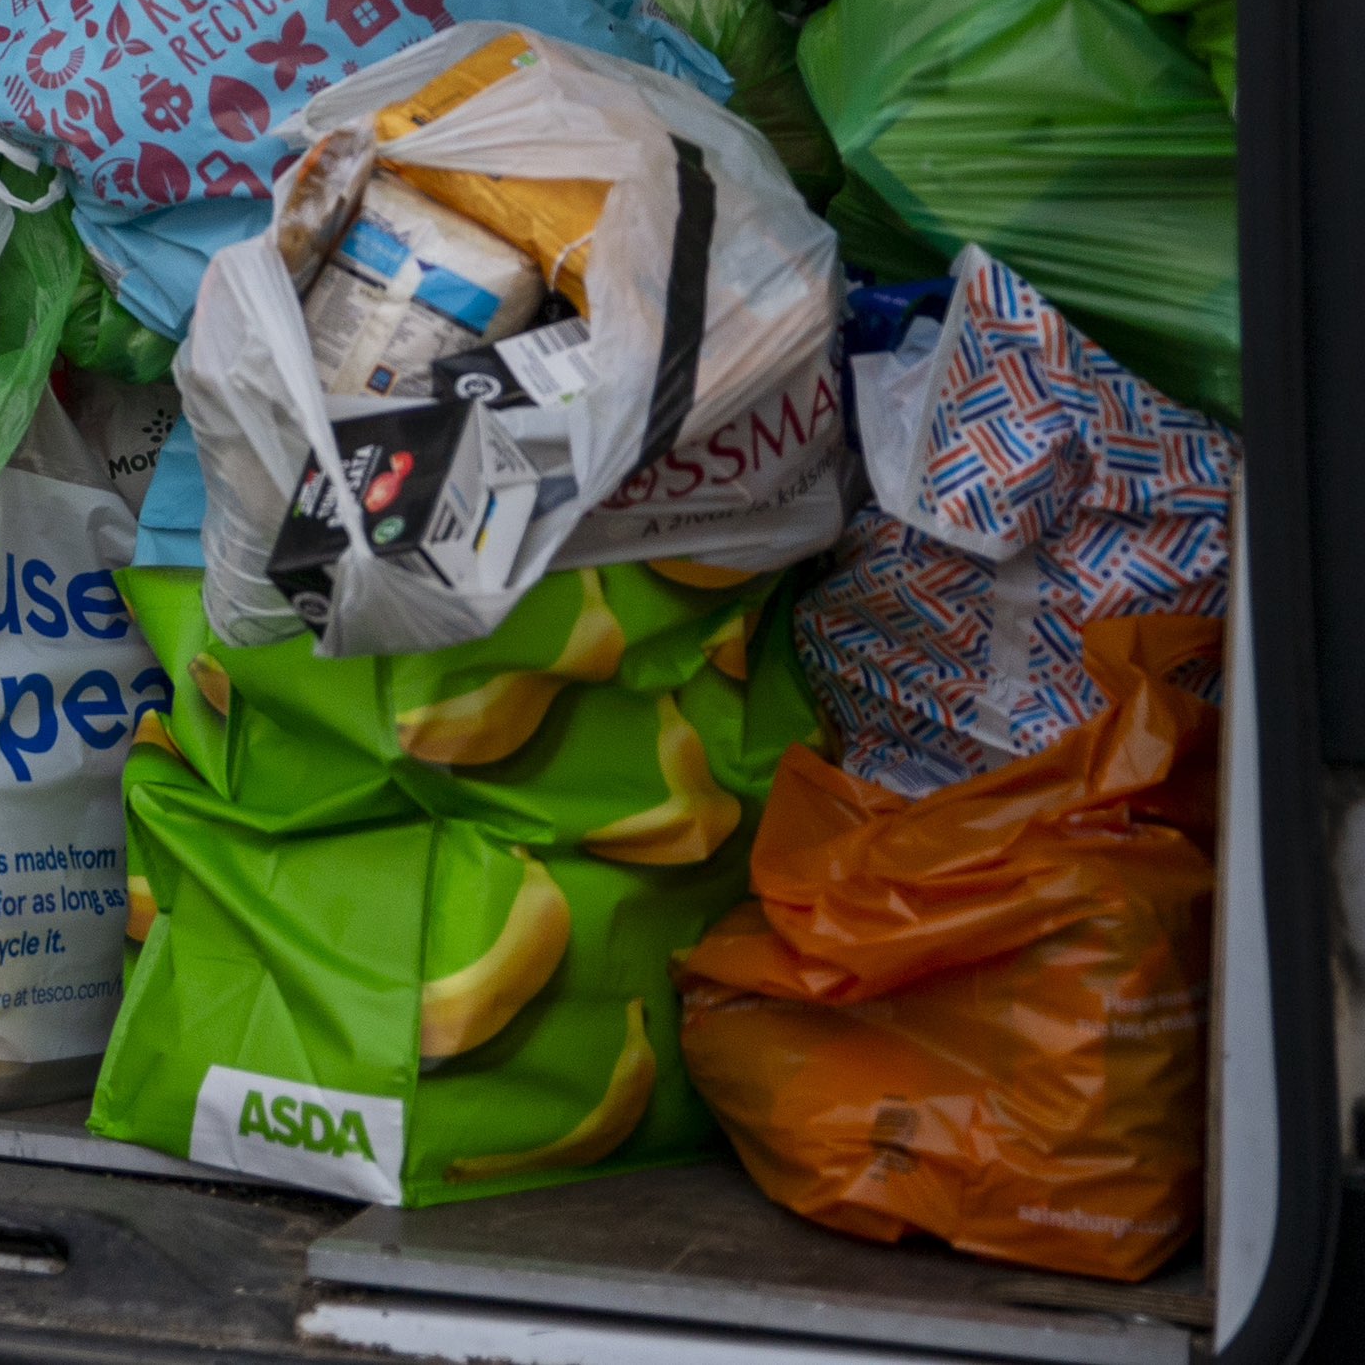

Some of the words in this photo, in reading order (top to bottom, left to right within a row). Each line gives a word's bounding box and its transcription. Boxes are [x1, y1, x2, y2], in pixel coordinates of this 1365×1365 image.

[15, 843, 67, 873] made
[68, 842, 117, 871] from
[32, 891, 57, 915] as
[61, 884, 106, 917] long
[103, 887, 126, 908] as
[45, 928, 67, 954] it.
[14, 988, 28, 1007] at
[238, 1089, 378, 1163] ASDA
